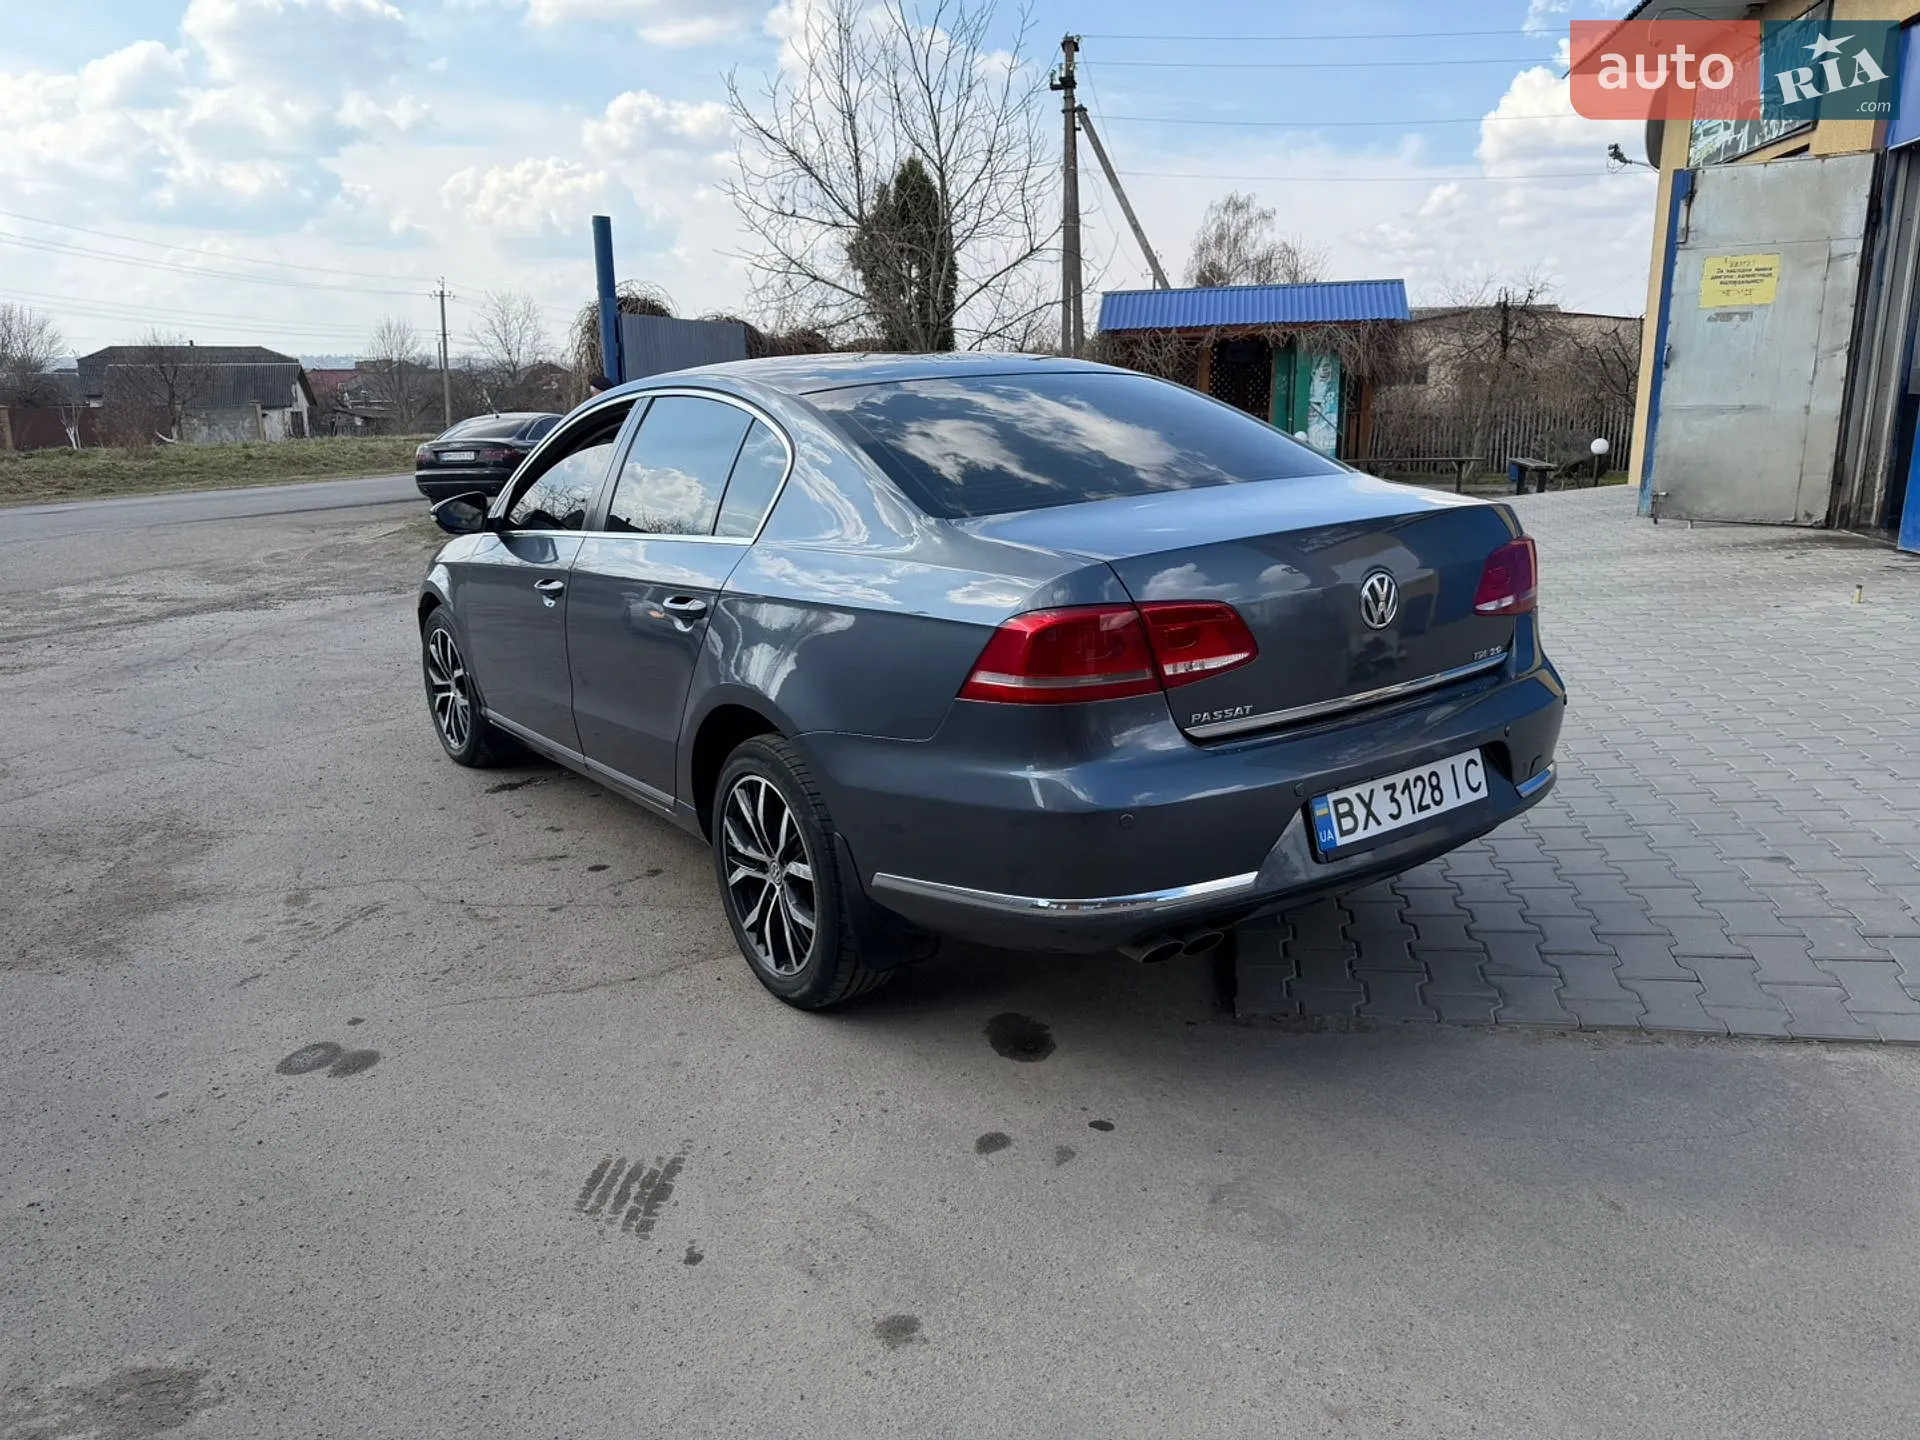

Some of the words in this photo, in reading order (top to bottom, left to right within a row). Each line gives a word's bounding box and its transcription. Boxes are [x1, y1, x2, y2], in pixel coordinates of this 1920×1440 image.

[1191, 705, 1253, 724] PASSAT
[1332, 788, 1382, 838] BX
[1383, 770, 1443, 821] 3128
[1451, 758, 1482, 800] IC
[1319, 829, 1335, 843] UA
